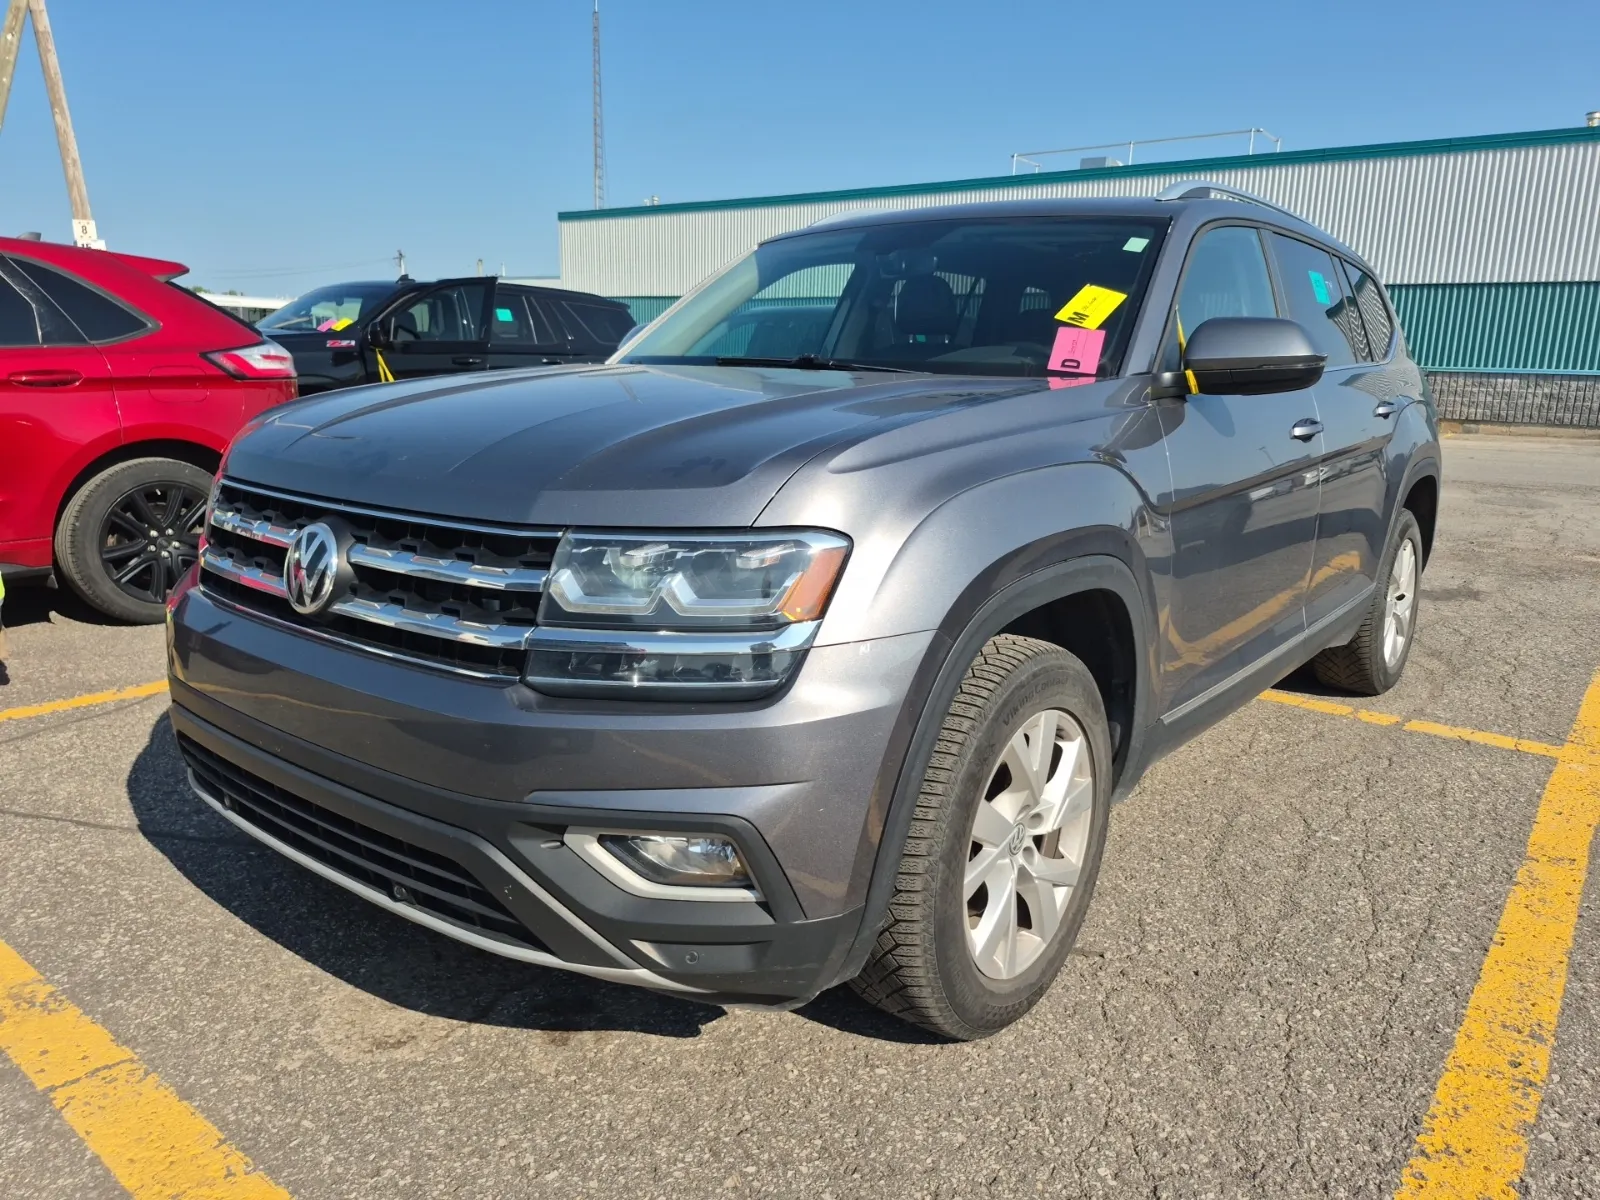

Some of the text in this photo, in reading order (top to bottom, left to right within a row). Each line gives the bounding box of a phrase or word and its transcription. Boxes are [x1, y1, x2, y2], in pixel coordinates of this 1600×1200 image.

[81, 225, 88, 234] 8
[1067, 312, 1089, 324] M
[1060, 358, 1081, 370] D
[1003, 677, 1069, 726] VikingContact
